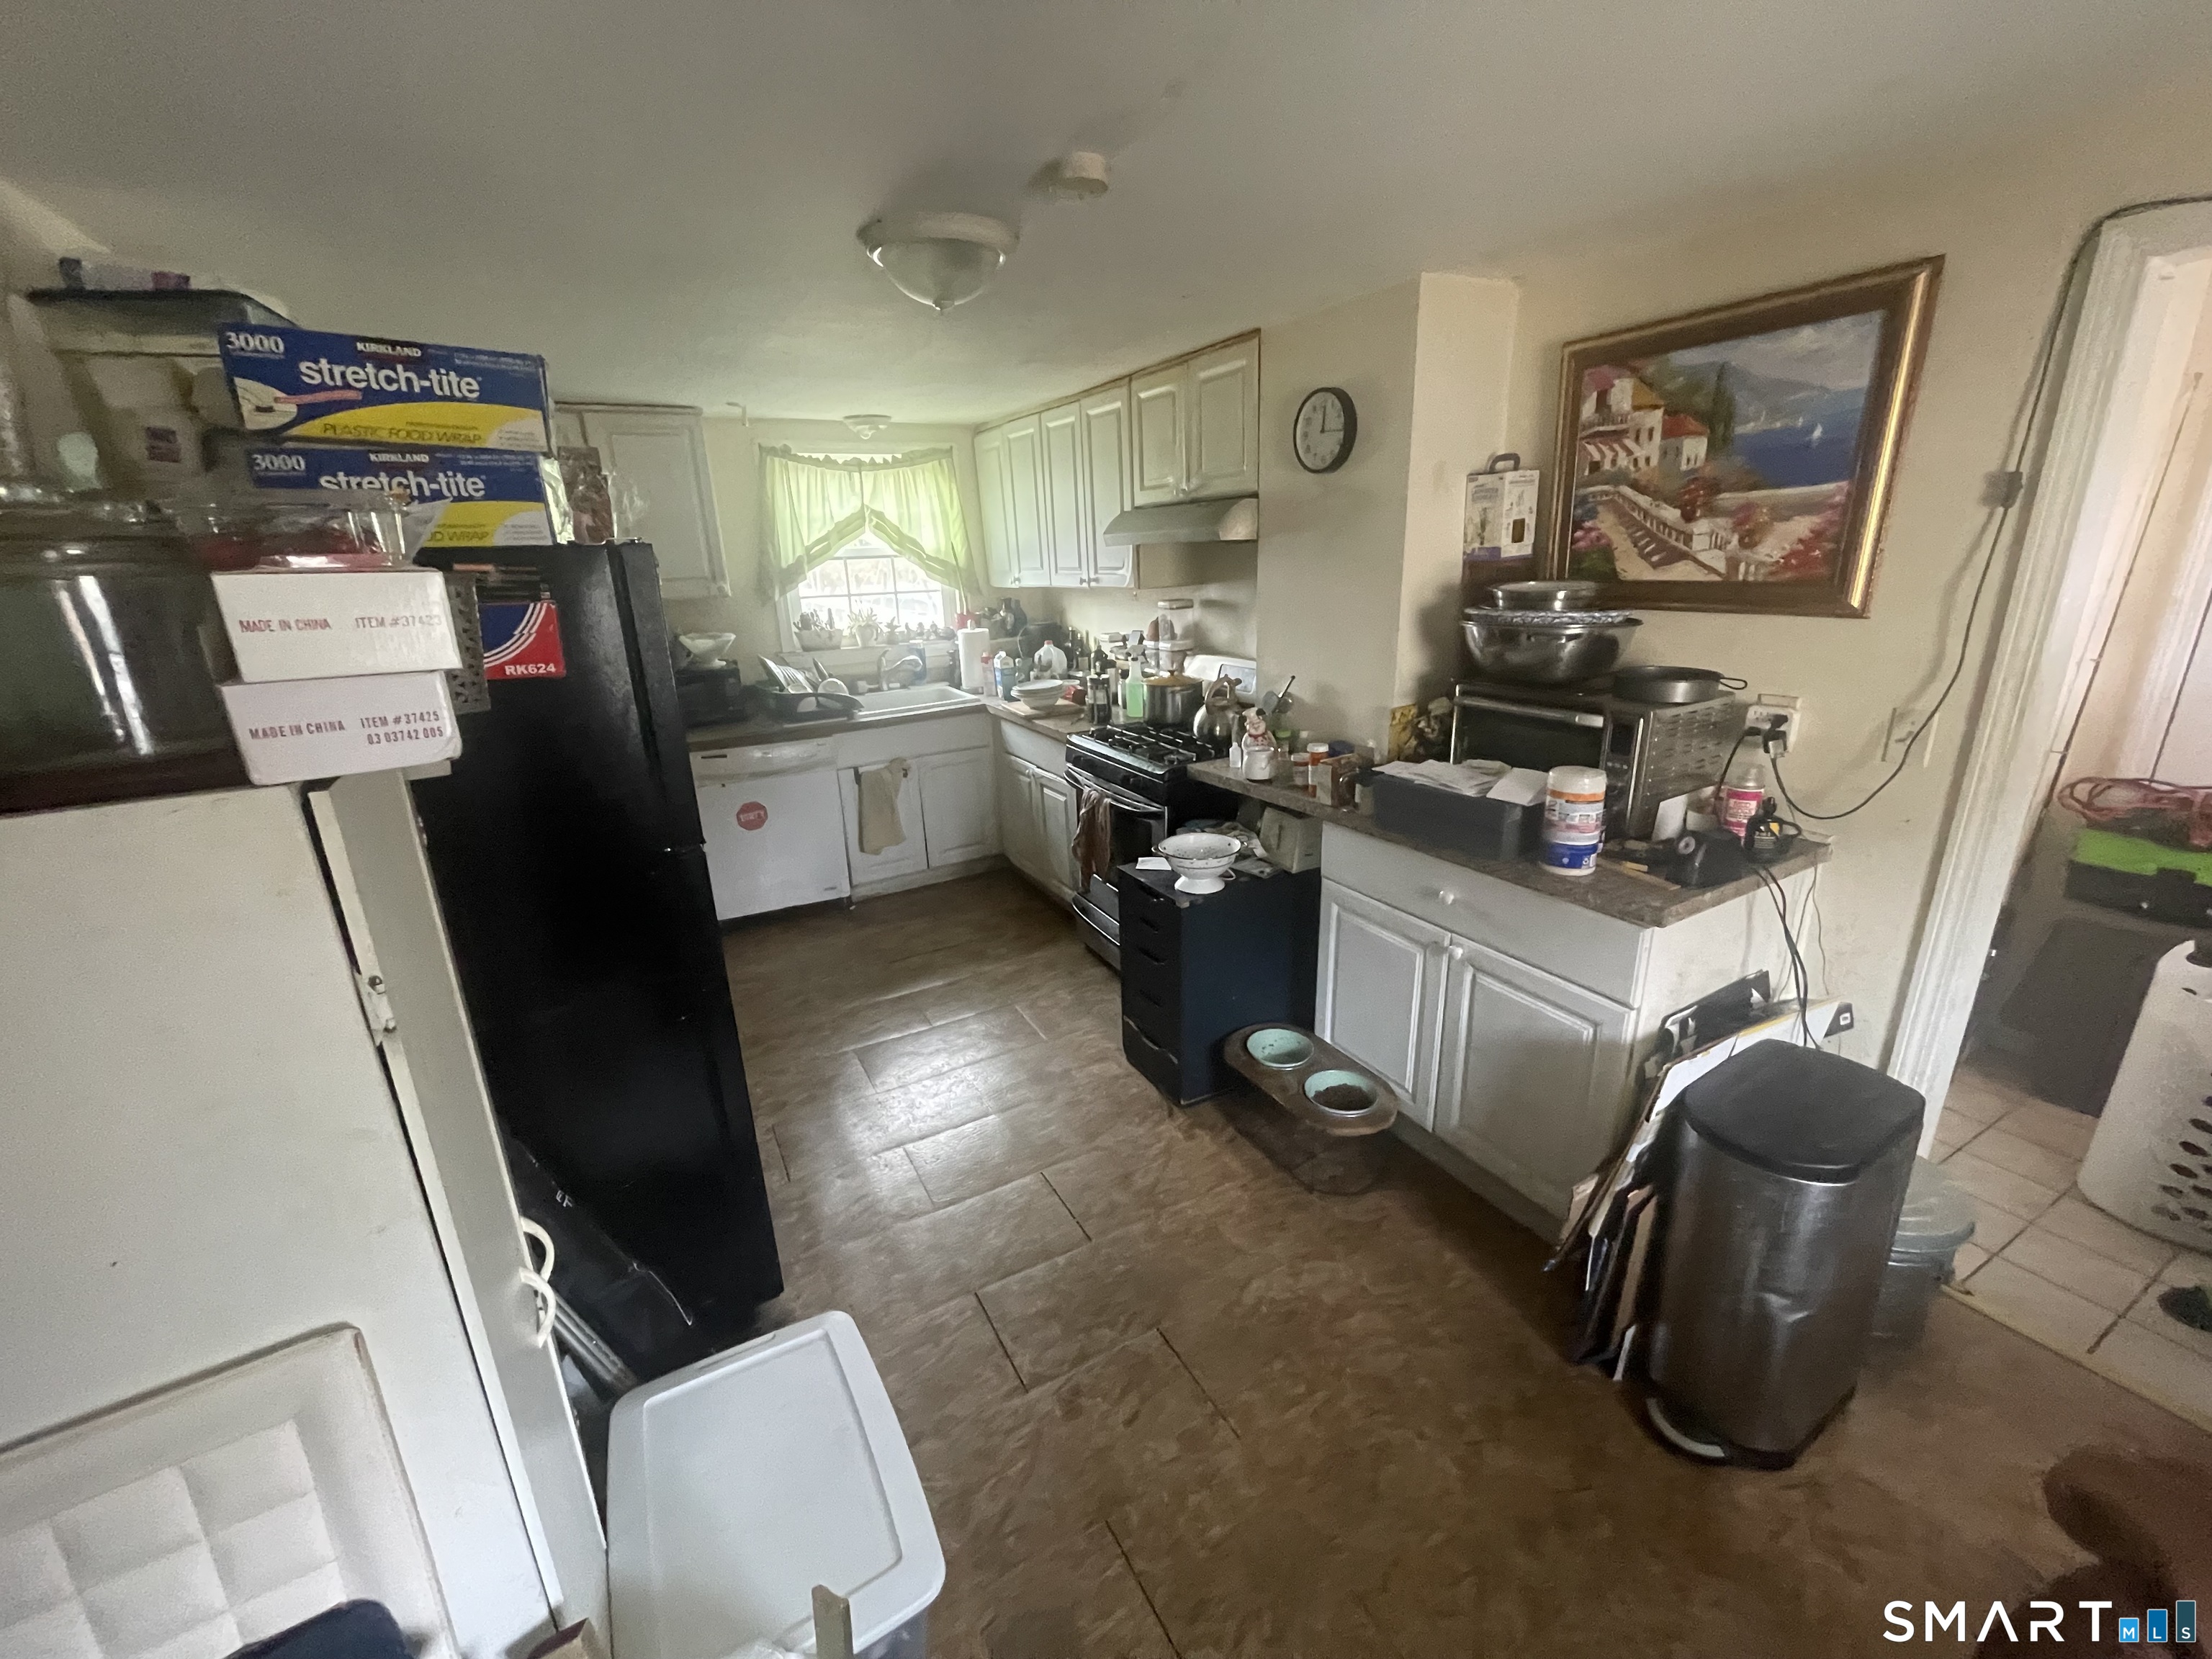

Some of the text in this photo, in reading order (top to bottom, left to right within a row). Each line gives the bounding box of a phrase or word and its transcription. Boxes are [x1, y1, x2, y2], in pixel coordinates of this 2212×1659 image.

[225, 331, 284, 354] 3000
[356, 341, 422, 357] KIRKLAND
[299, 358, 480, 398] stretch-tite
[389, 428, 432, 441] FOOD
[436, 431, 482, 444] WRAP
[252, 454, 306, 471] 3000
[369, 453, 430, 463] KIRKLAND
[448, 531, 489, 541] WRAP
[239, 619, 333, 632] MADE IN CHINA
[355, 617, 386, 629] ITEM
[505, 663, 557, 676] RK624
[360, 716, 389, 729] ITEM
[249, 721, 345, 739] MADE IN CHINA
